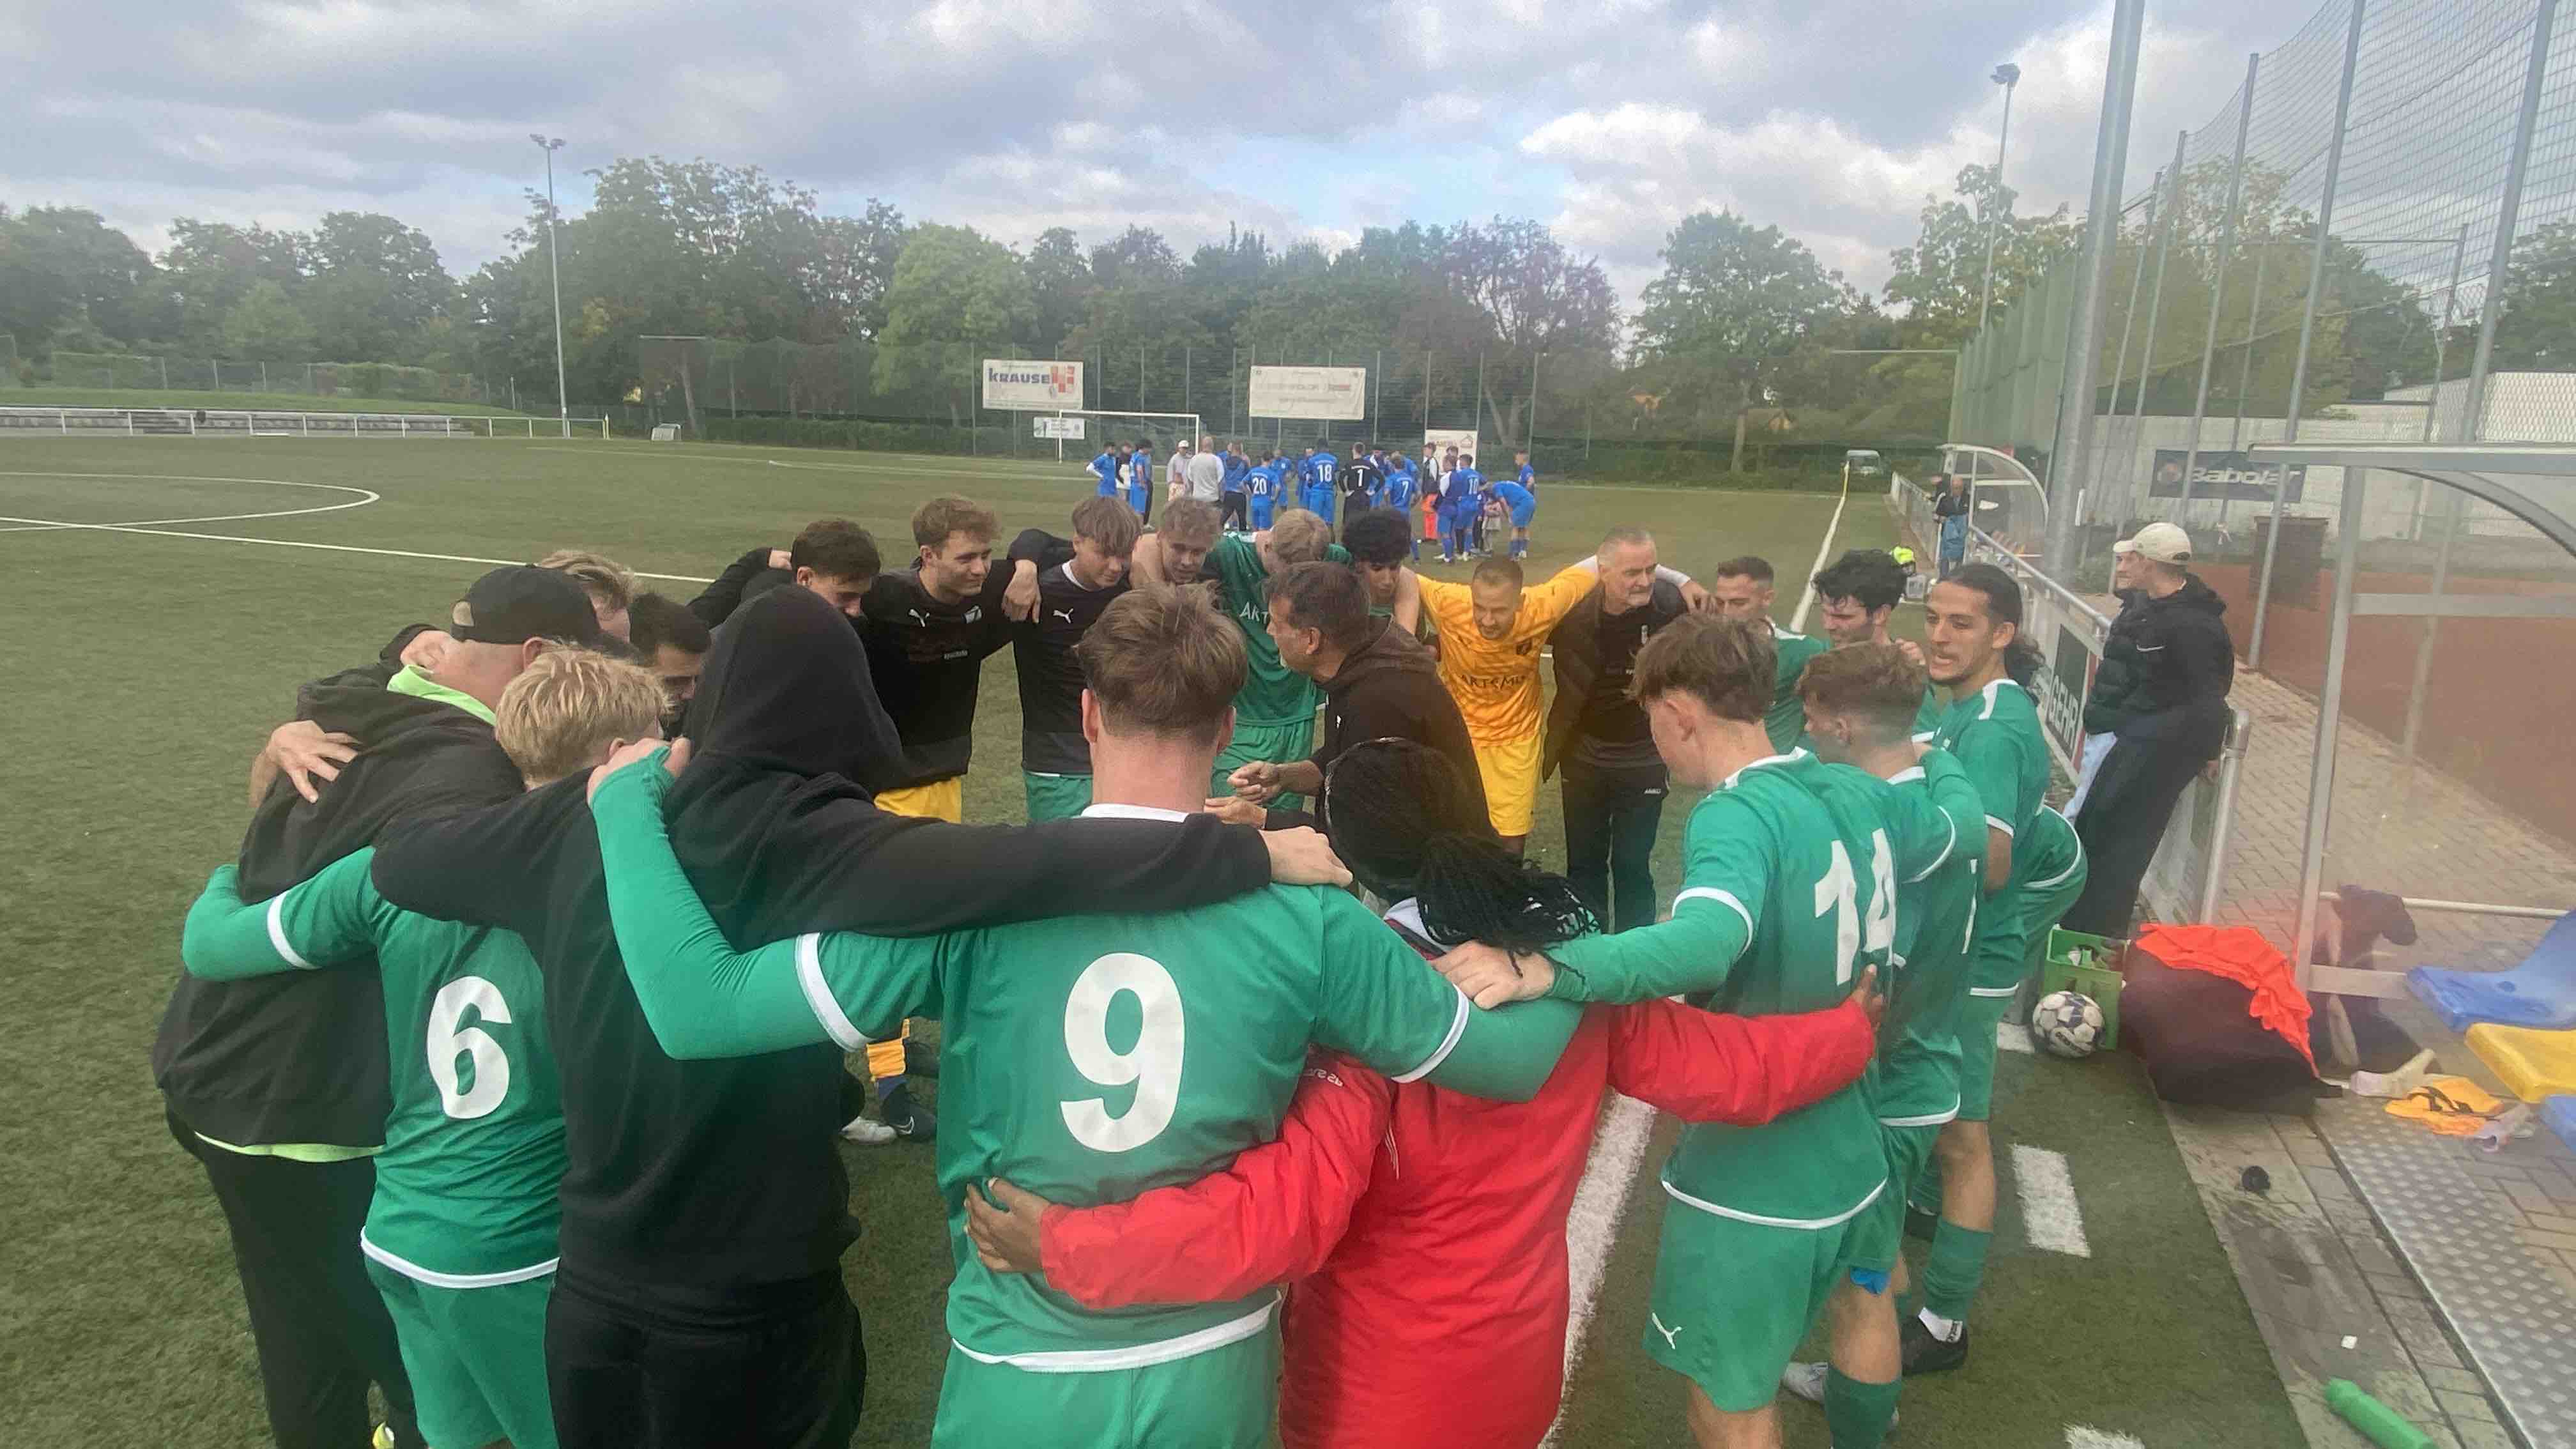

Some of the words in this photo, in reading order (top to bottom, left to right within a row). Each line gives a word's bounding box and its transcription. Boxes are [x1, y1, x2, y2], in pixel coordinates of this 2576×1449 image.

[1253, 477, 1268, 495] 20
[1317, 464, 1332, 482] 18
[1357, 469, 1363, 487] 1
[1402, 480, 1409, 498] 7
[2048, 674, 2079, 750] GEHR
[1815, 828, 1906, 986] 14
[426, 976, 512, 1119] 6
[1061, 953, 1185, 1153] 9
